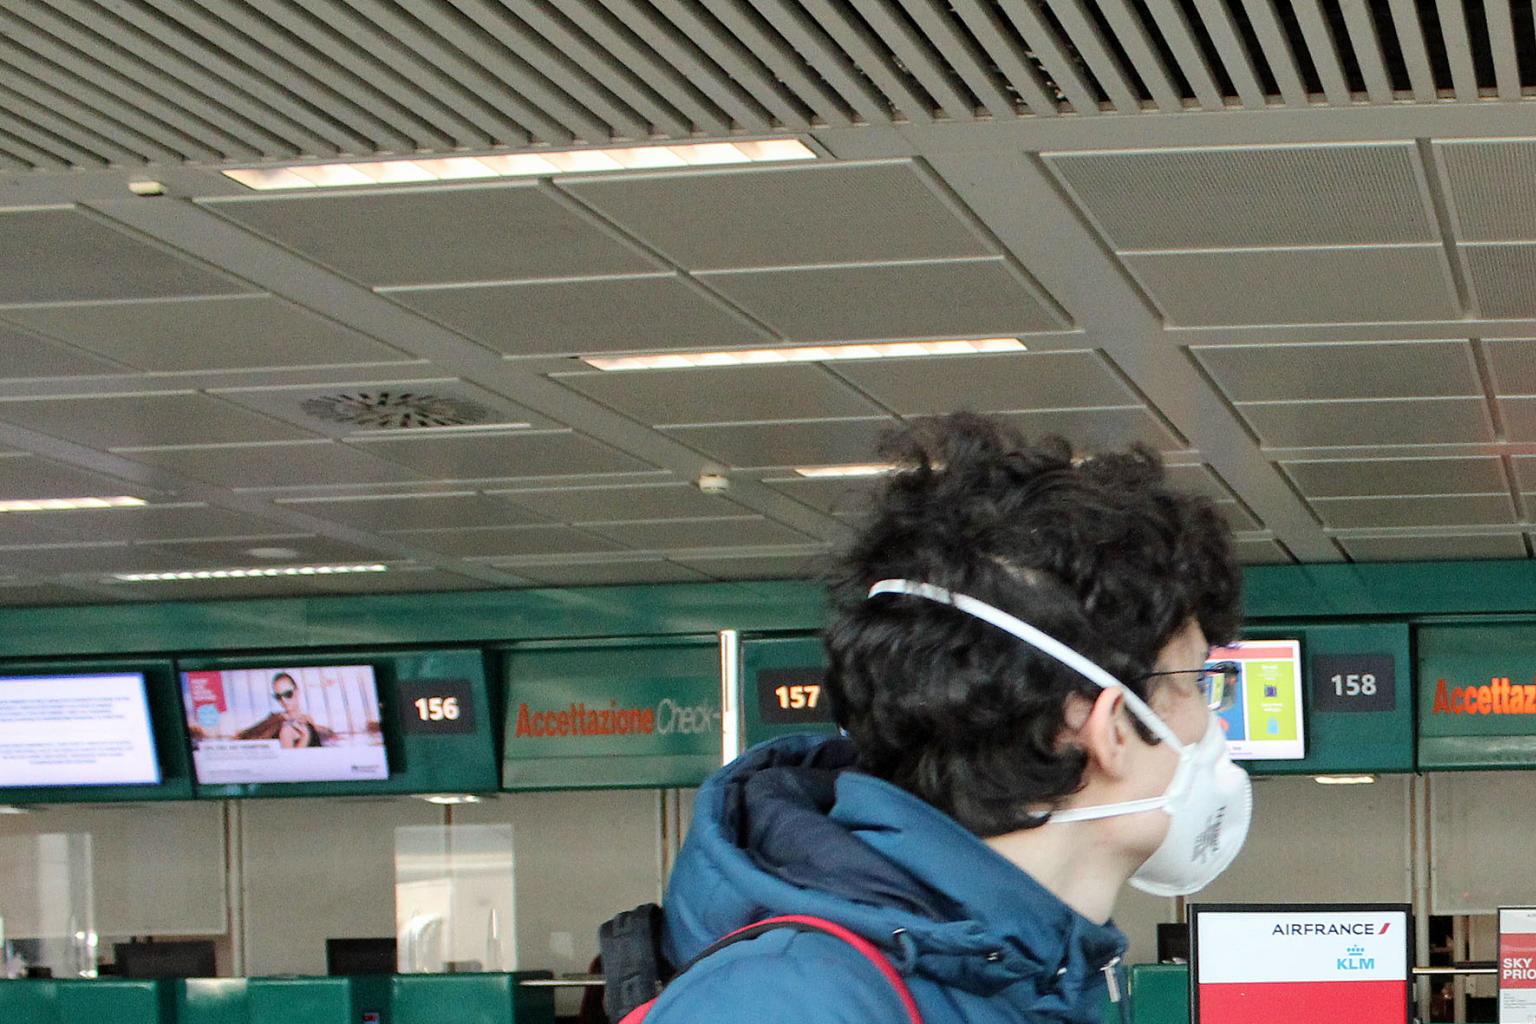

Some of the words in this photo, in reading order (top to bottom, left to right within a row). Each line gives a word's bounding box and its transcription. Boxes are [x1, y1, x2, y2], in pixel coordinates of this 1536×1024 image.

[1330, 674, 1376, 696] 158
[775, 685, 820, 709] 157
[415, 697, 459, 720] 156
[516, 700, 655, 737] Accettazione
[1272, 923, 1374, 935] AIRFRANCE
[1337, 958, 1375, 970] KLM
[1503, 958, 1532, 968] SKY
